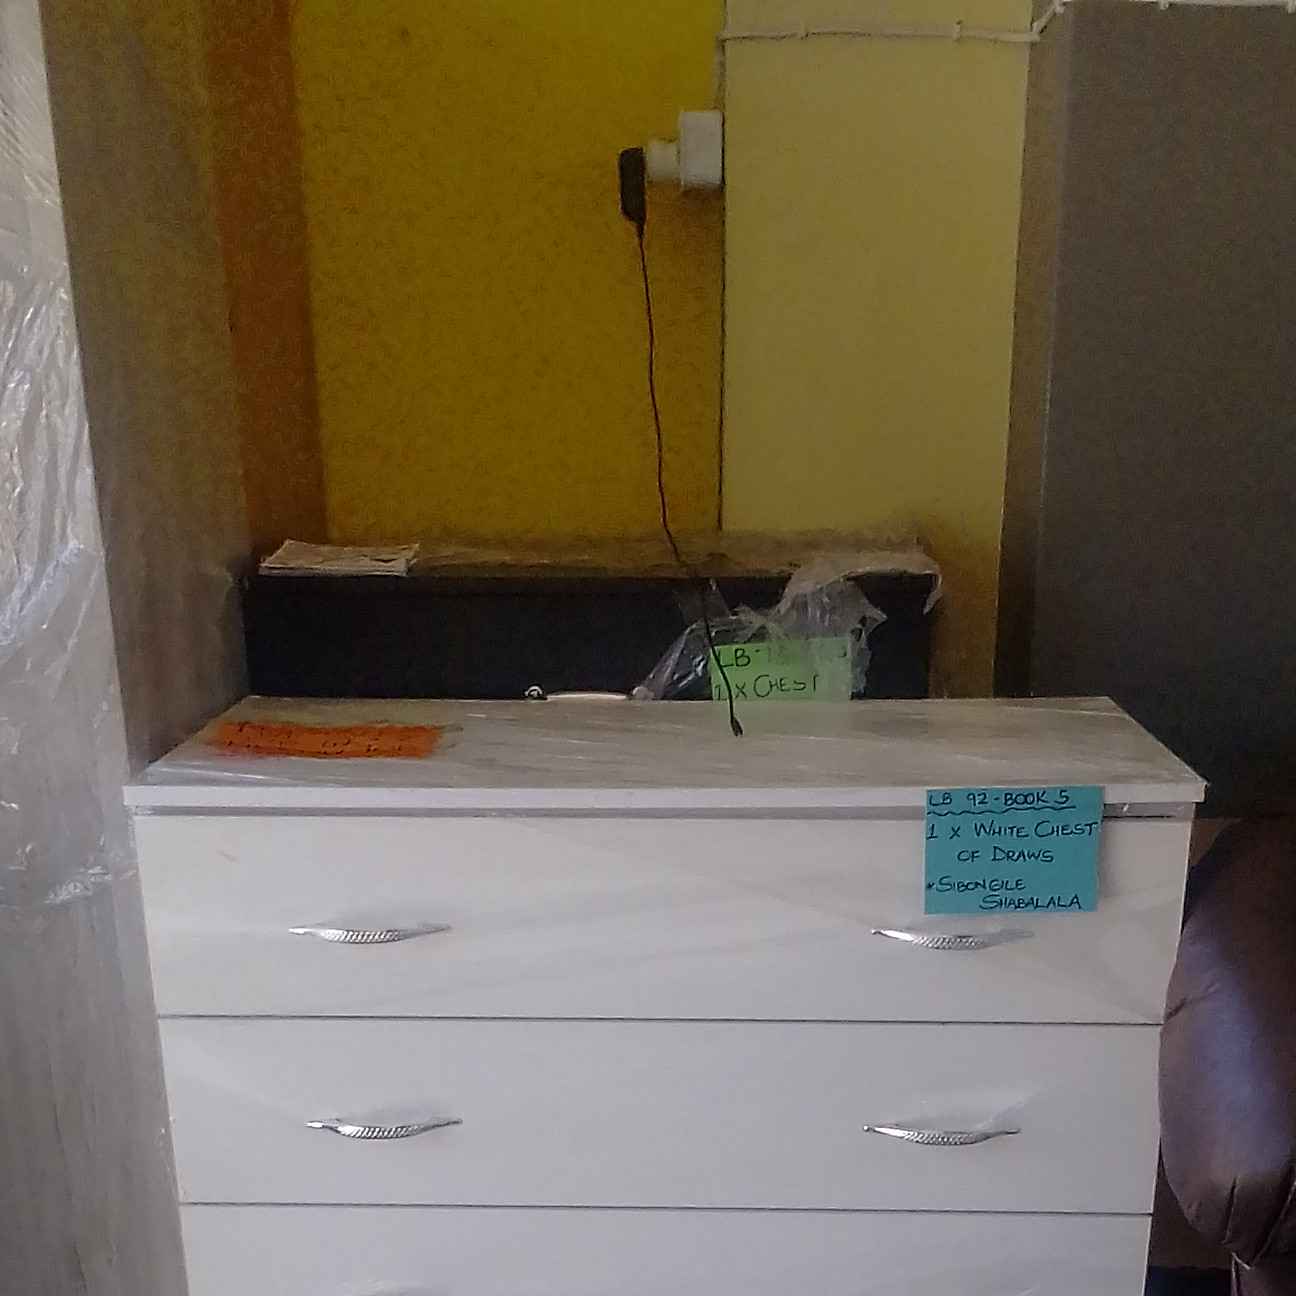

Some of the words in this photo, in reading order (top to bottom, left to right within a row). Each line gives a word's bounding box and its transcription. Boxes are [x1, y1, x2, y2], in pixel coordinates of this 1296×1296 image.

[928, 791, 953, 807] LB
[1054, 789, 1070, 804] 5
[926, 823, 938, 840] 1
[974, 819, 1029, 838] WHITE
[1034, 820, 1098, 838] CHEST
[956, 849, 981, 863] OF
[991, 845, 1055, 863] DRAWS
[978, 893, 1082, 910] SHABALALA
